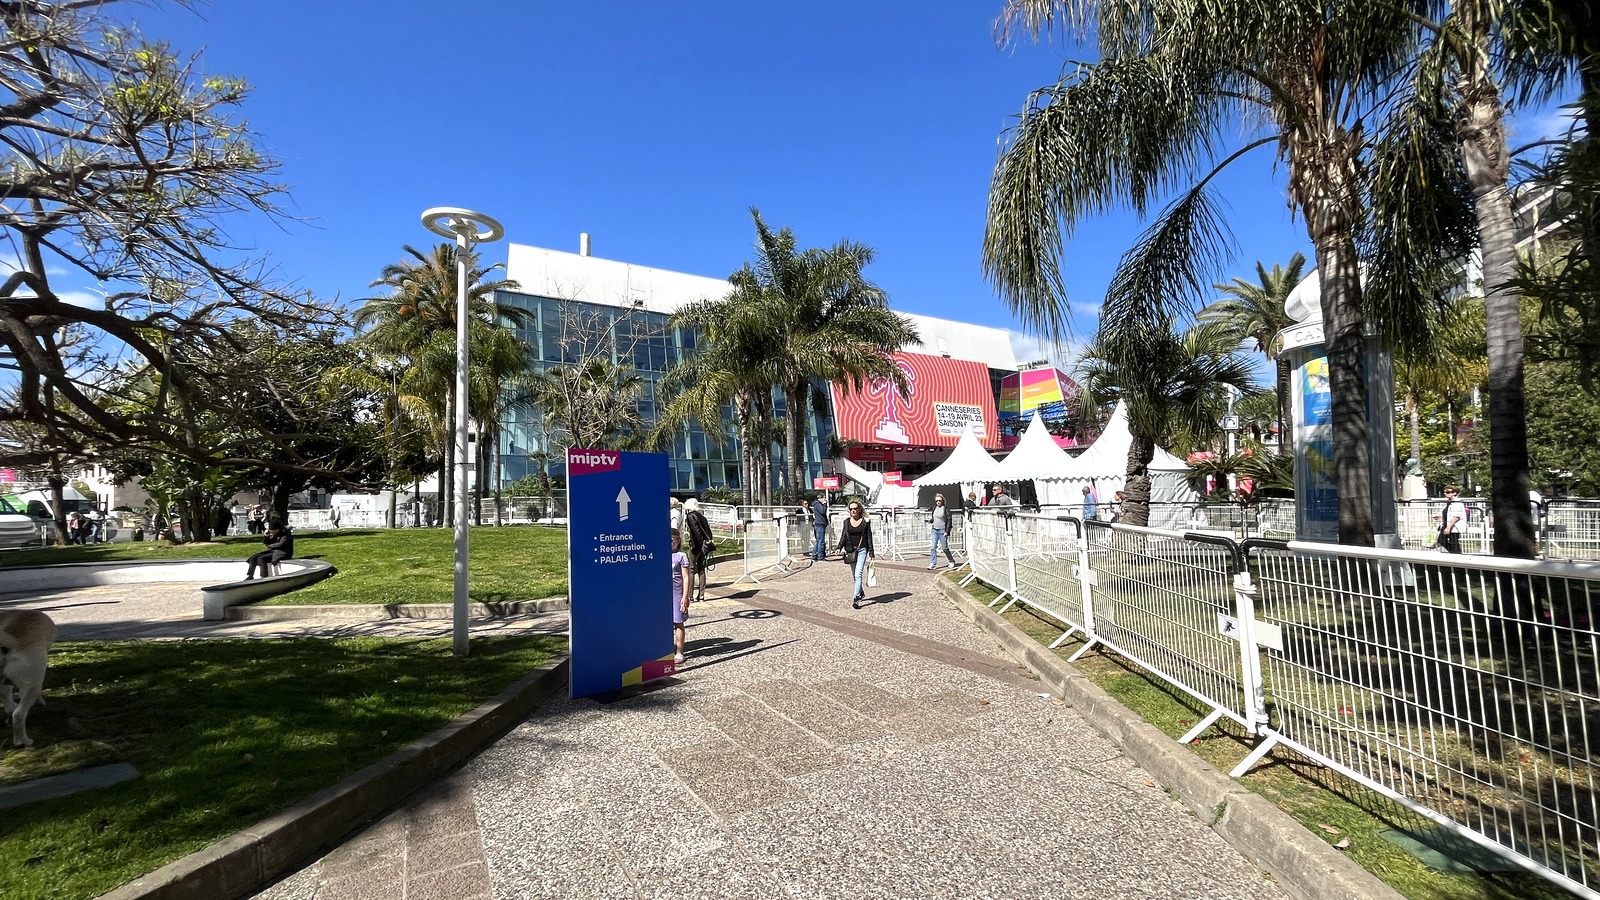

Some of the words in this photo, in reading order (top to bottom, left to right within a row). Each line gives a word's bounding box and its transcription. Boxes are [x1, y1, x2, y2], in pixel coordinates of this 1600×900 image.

[936, 404, 981, 414] CANNESERIES
[957, 413, 974, 421] AVRIL
[939, 419, 963, 428] SAISON
[570, 452, 616, 467] miptv
[599, 533, 633, 542] Entrance
[600, 543, 645, 554] Registration
[600, 554, 629, 564] PALAIS
[639, 553, 647, 561] to
